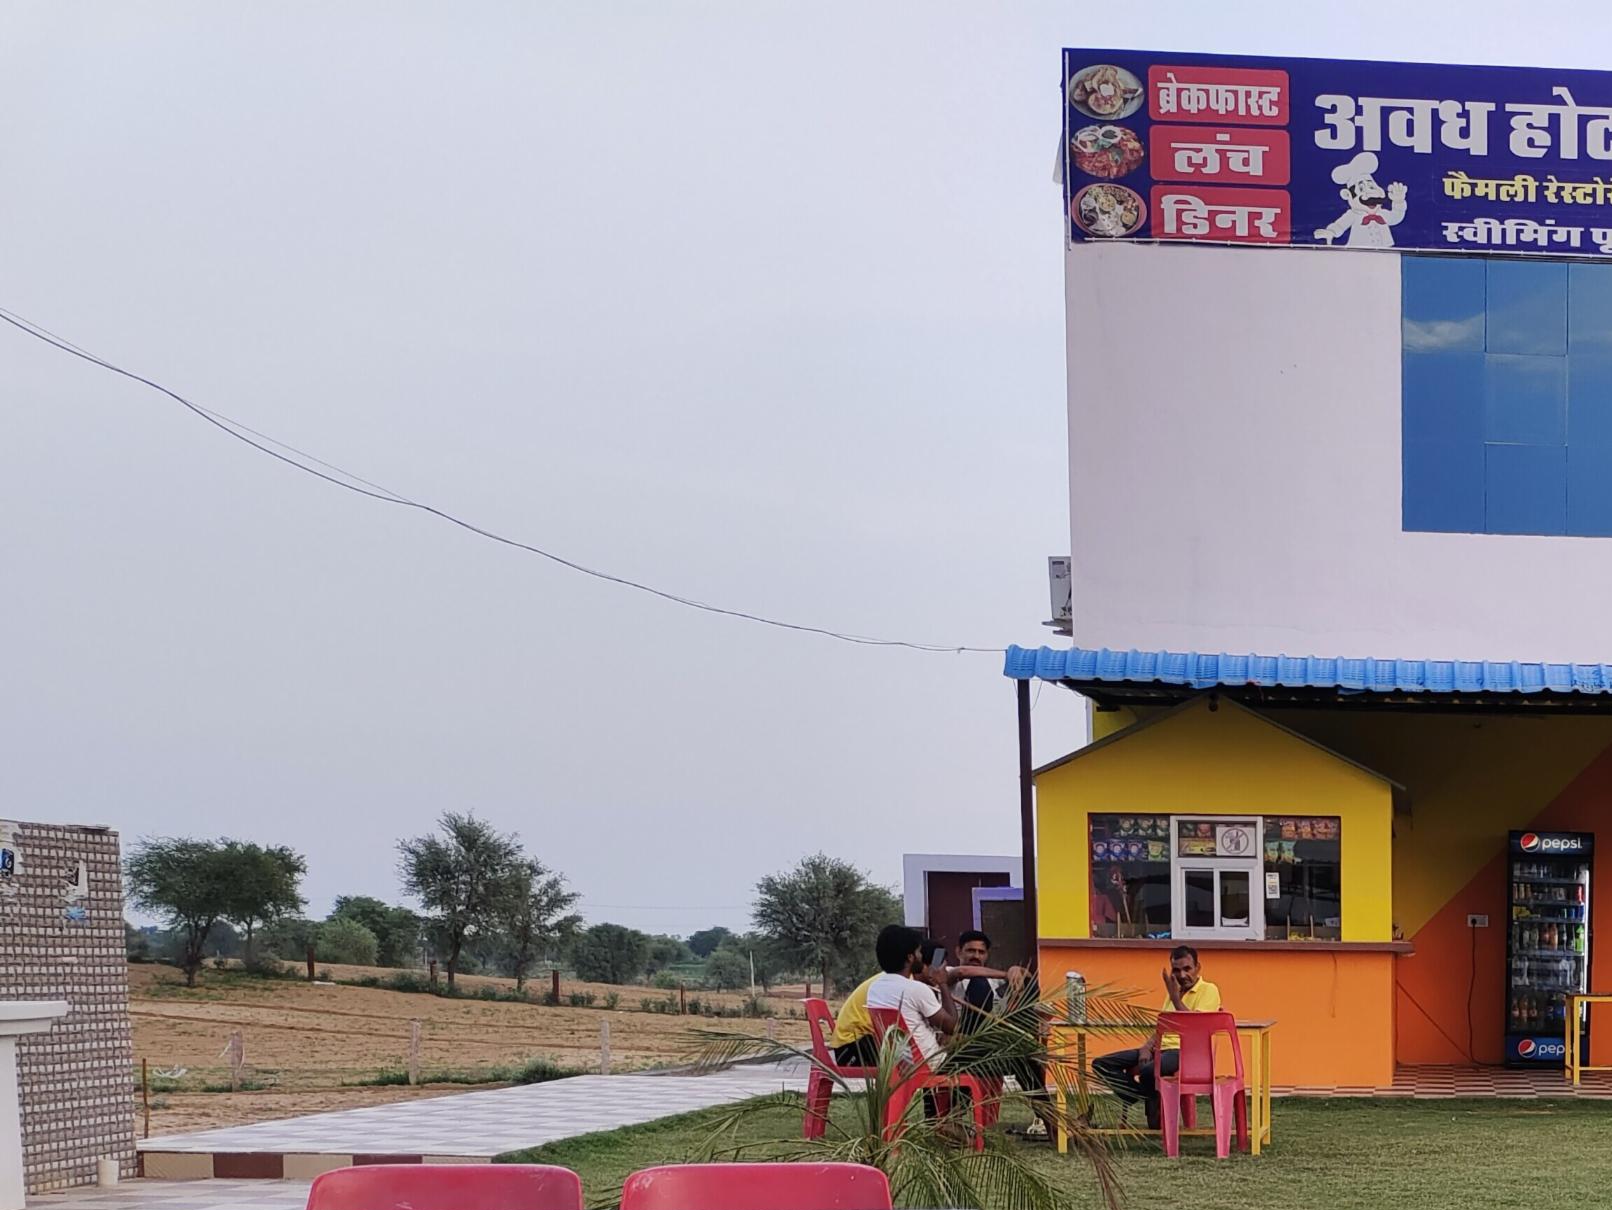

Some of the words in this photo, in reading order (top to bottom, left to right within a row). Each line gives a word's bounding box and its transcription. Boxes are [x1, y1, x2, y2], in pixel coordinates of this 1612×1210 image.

[1157, 72, 1281, 117] ब्रेकफास्ट
[1314, 94, 1496, 157] अवध
[1170, 133, 1270, 176] लंच
[1442, 171, 1539, 203] फैमली
[1160, 194, 1281, 238] डिनर
[1441, 217, 1585, 248] स्वीमिंग
[1542, 837, 1582, 851] pepsi
[1538, 1044, 1575, 1056] pep
